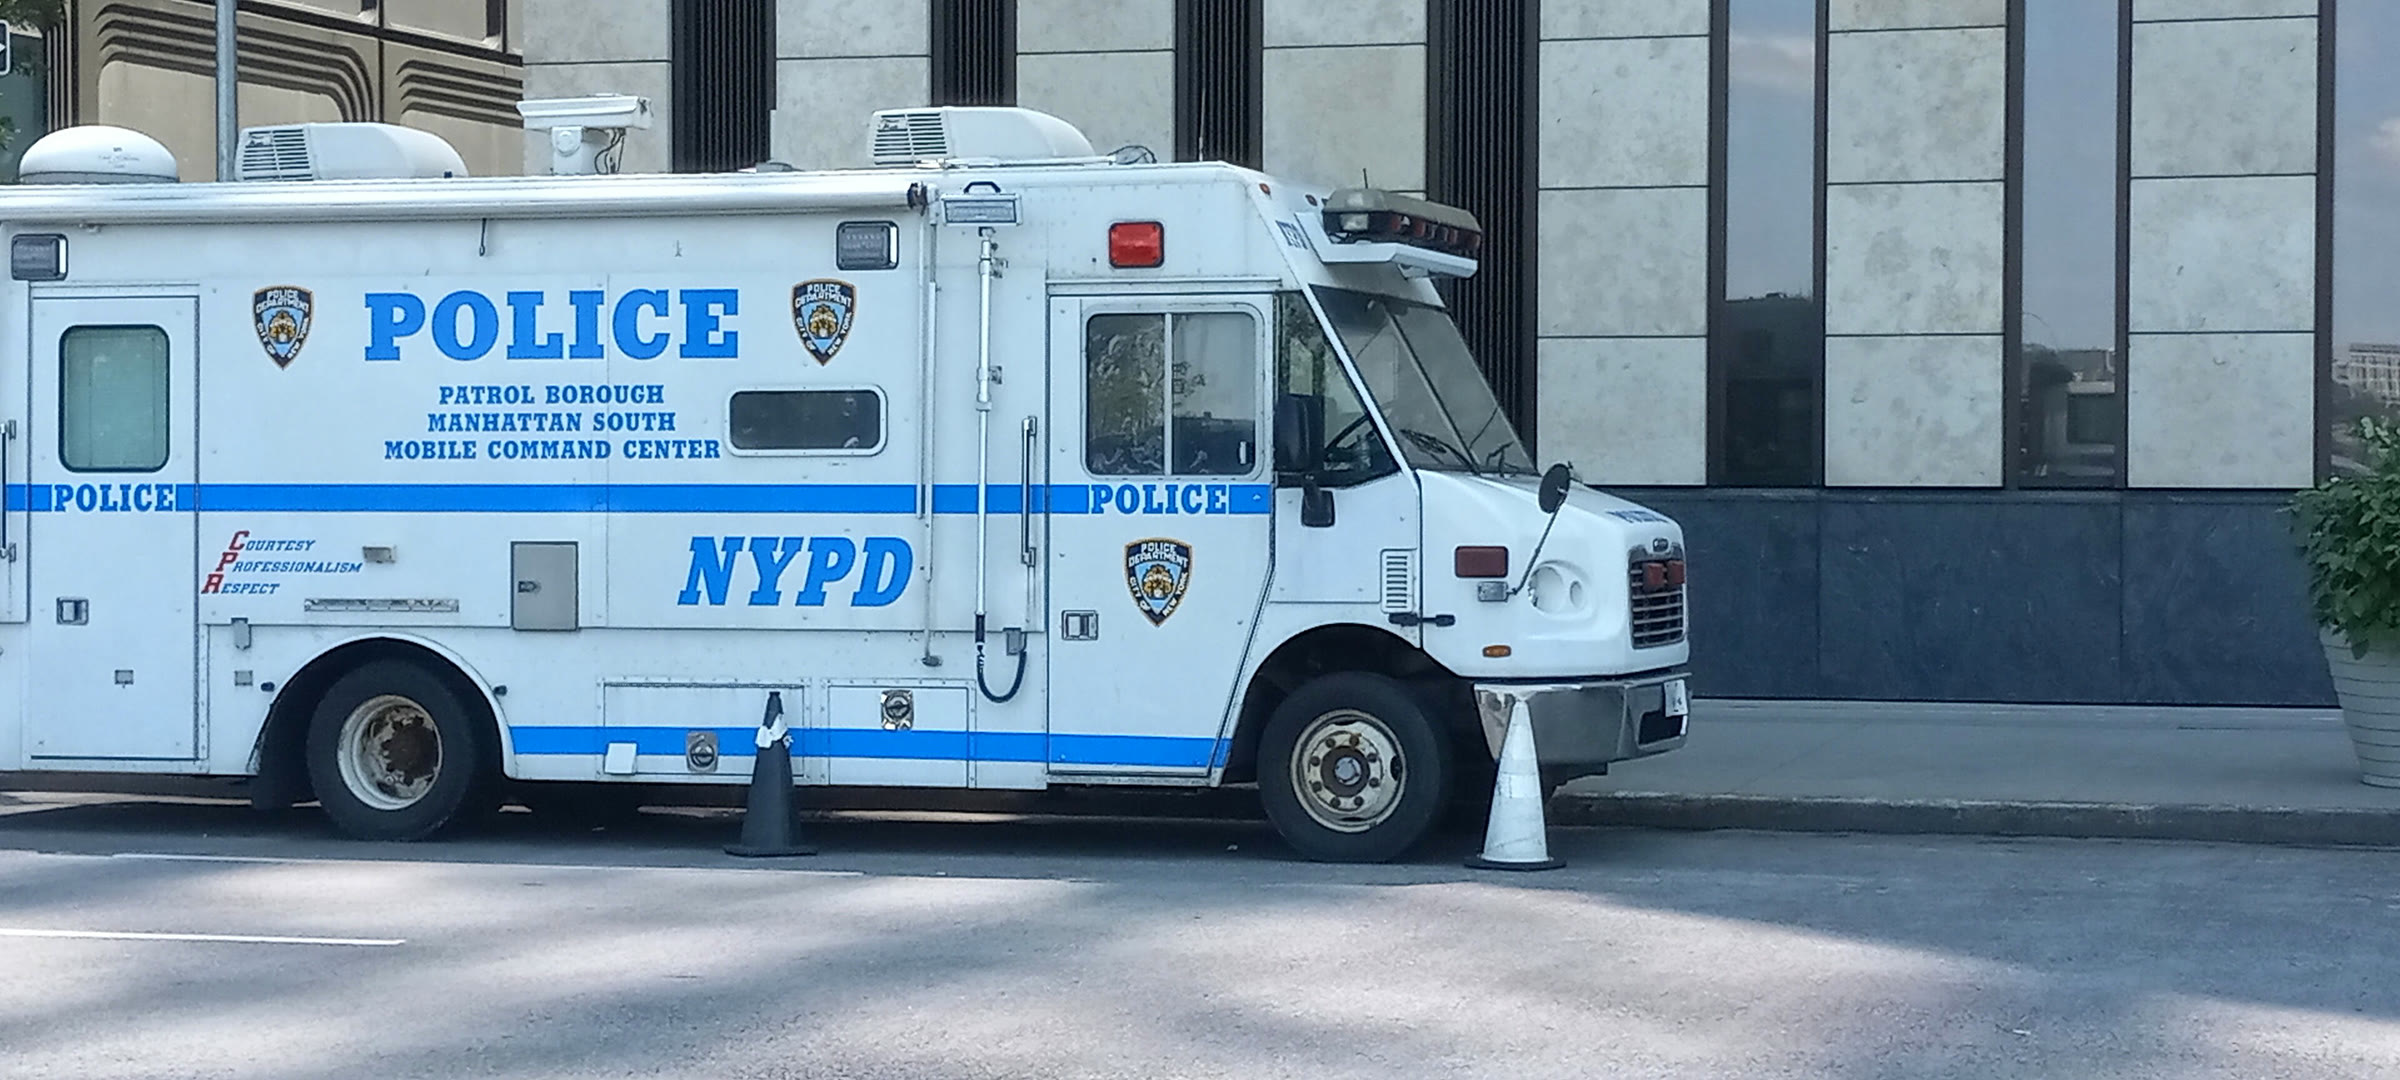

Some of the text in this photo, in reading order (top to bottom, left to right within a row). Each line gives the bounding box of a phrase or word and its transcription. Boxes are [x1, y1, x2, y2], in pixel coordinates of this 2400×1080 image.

[807, 283, 841, 294] POLICE
[364, 289, 739, 361] POLICE
[439, 384, 665, 405] PATROL BOROUGH
[427, 411, 676, 432] MANHATTAN SOUTH
[384, 439, 721, 460] MOBILE COMMAND CENTER
[53, 483, 174, 513] POLICE
[1090, 483, 1227, 515] POLICE
[228, 530, 316, 551] COURTESY
[1140, 542, 1177, 553] POLICE
[215, 551, 364, 574] PROFESSIONALISM
[1128, 550, 1188, 568] DEPARTMENT
[677, 535, 914, 608] NYPD
[200, 573, 280, 595] RESPECT
